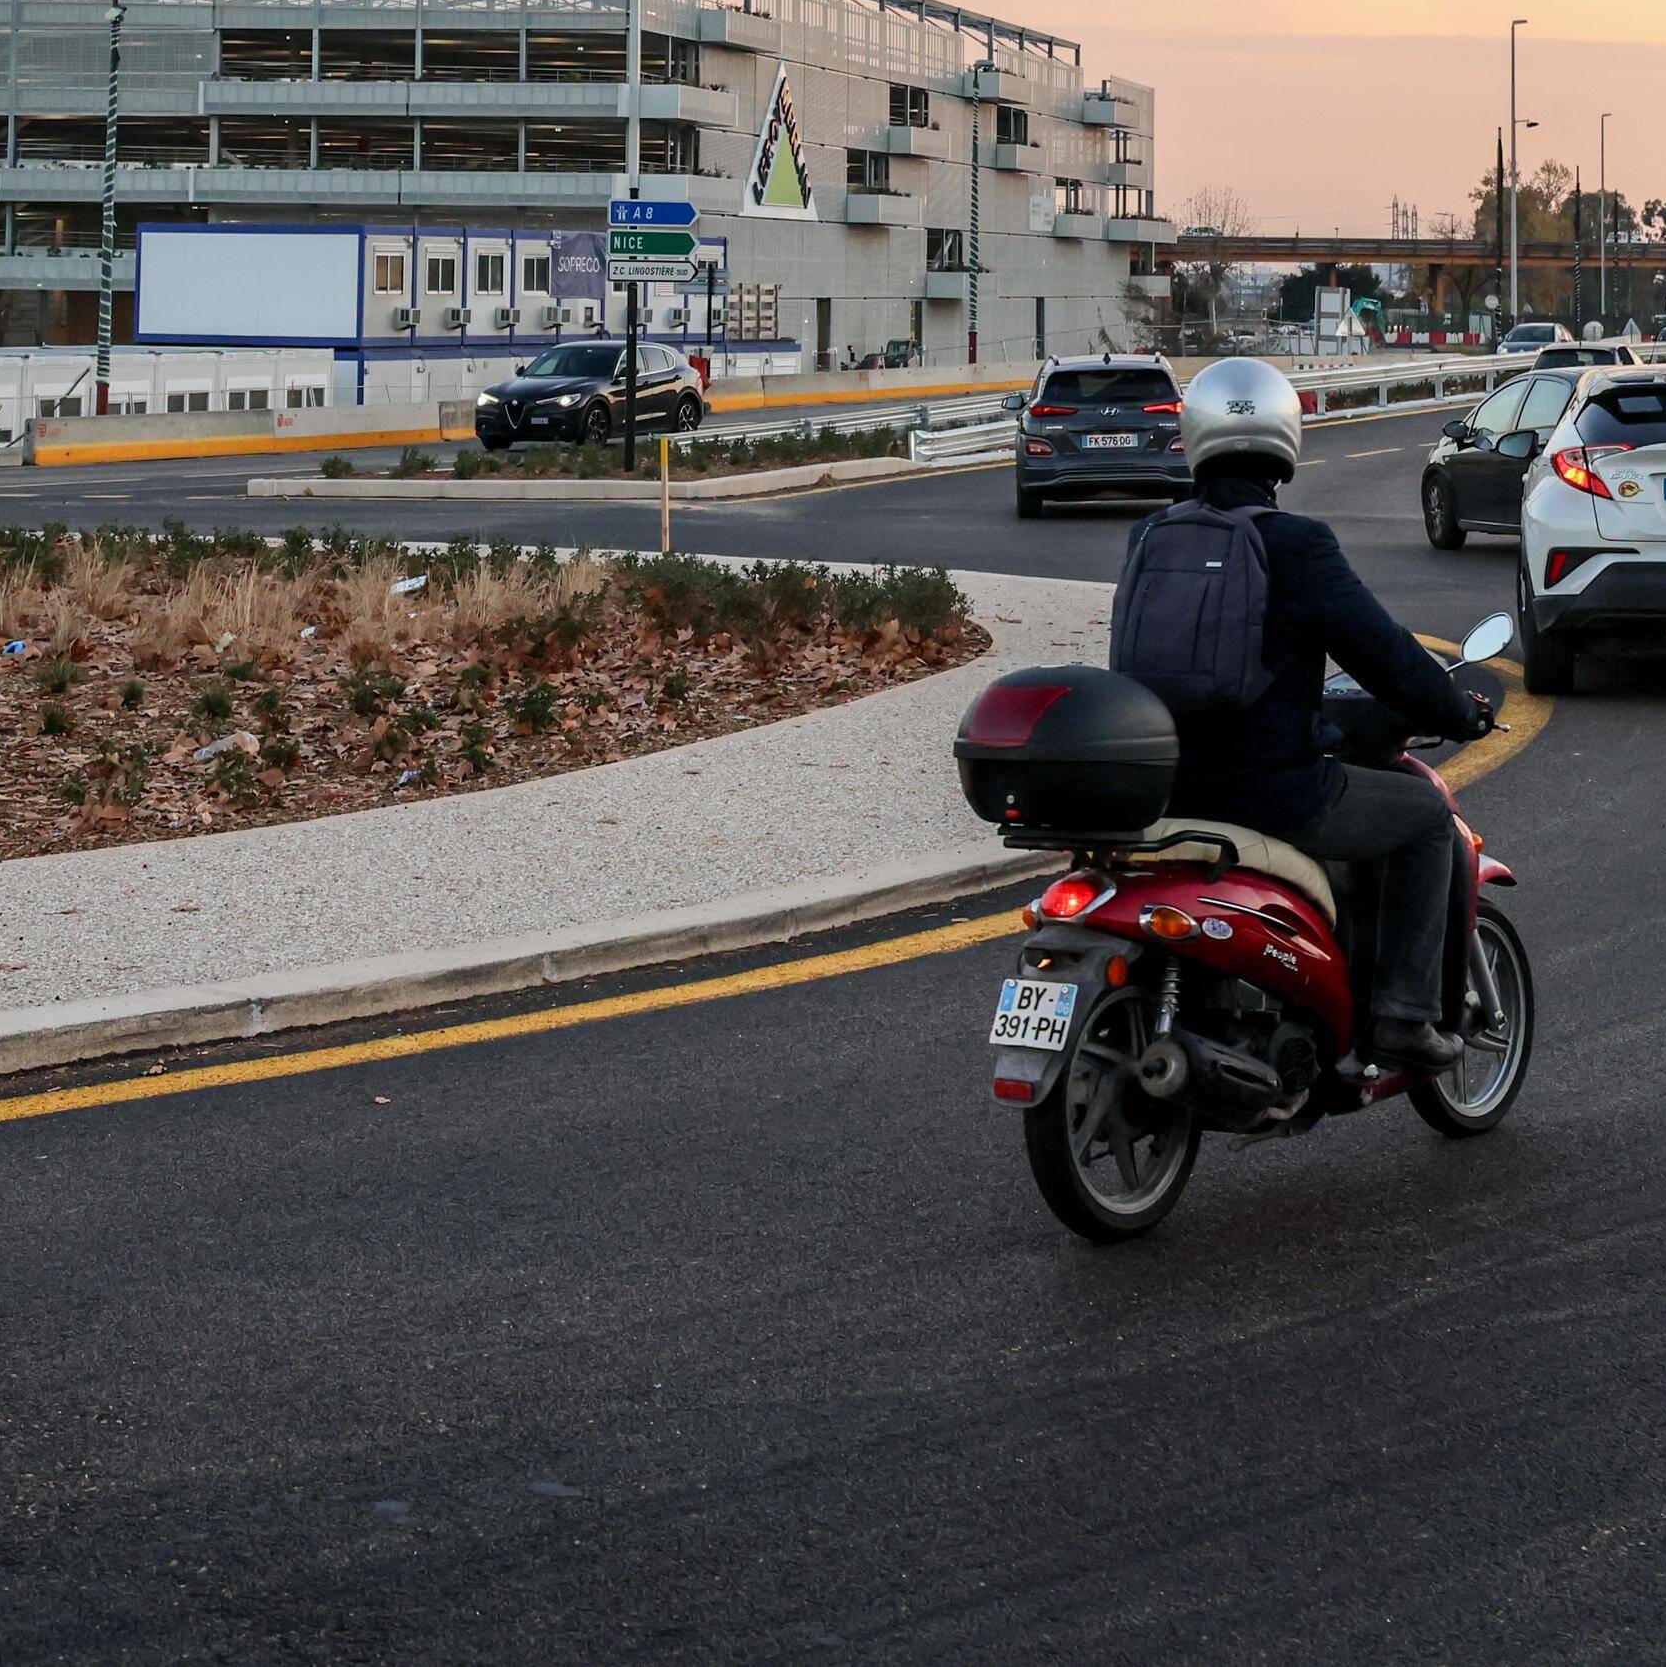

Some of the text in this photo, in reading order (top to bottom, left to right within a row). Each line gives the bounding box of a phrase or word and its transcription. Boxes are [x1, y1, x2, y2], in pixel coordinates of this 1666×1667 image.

[633, 206, 654, 219] A 8
[614, 236, 643, 250] NICE
[995, 1014, 1067, 1044] 391-PH
